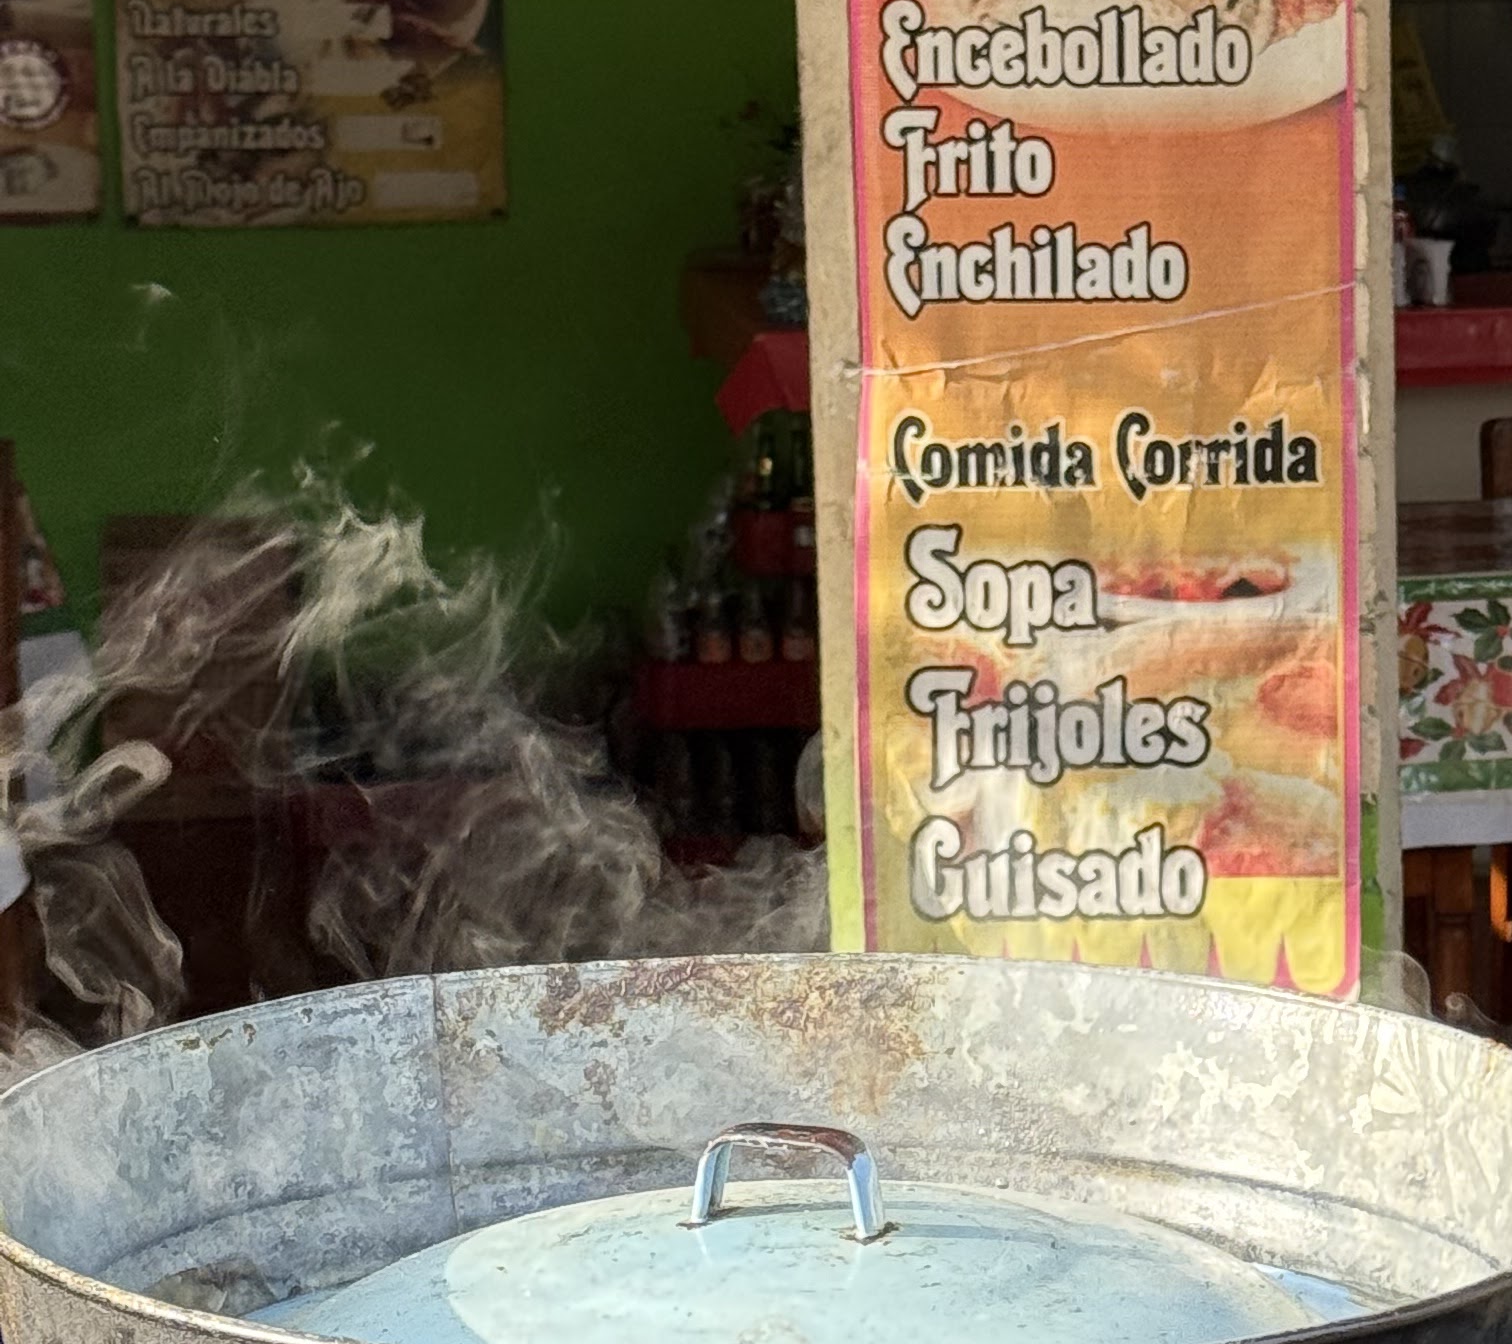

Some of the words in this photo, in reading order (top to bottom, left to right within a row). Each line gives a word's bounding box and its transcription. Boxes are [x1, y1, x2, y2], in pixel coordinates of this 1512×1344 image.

[881, 104, 1055, 212] Frito
[884, 213, 1189, 319] Enchilado
[891, 412, 1099, 506] Comida
[1116, 410, 1322, 503] Corrida
[905, 523, 1099, 647] Sopa
[906, 666, 1212, 791] Frijoles
[909, 816, 1208, 920] Guisado
